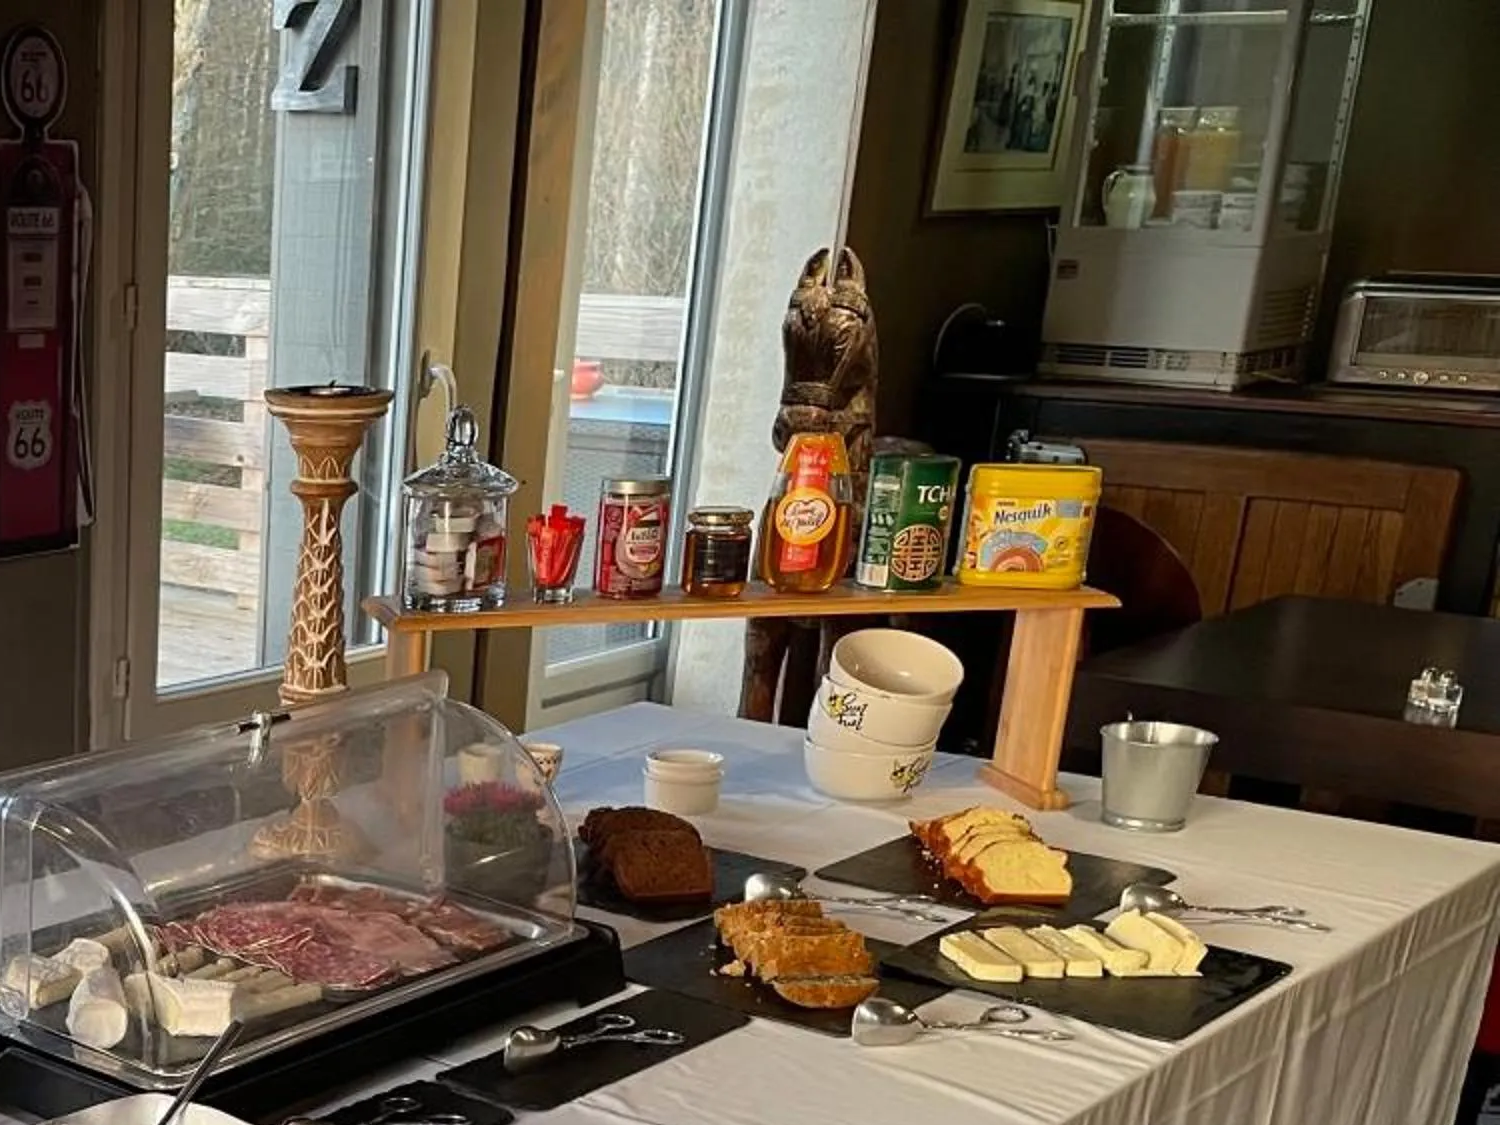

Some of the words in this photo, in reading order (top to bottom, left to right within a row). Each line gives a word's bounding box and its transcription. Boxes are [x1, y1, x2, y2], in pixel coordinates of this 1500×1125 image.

[20, 69, 49, 103] 66
[14, 427, 46, 458] 66
[994, 503, 1052, 525] Nesquik
